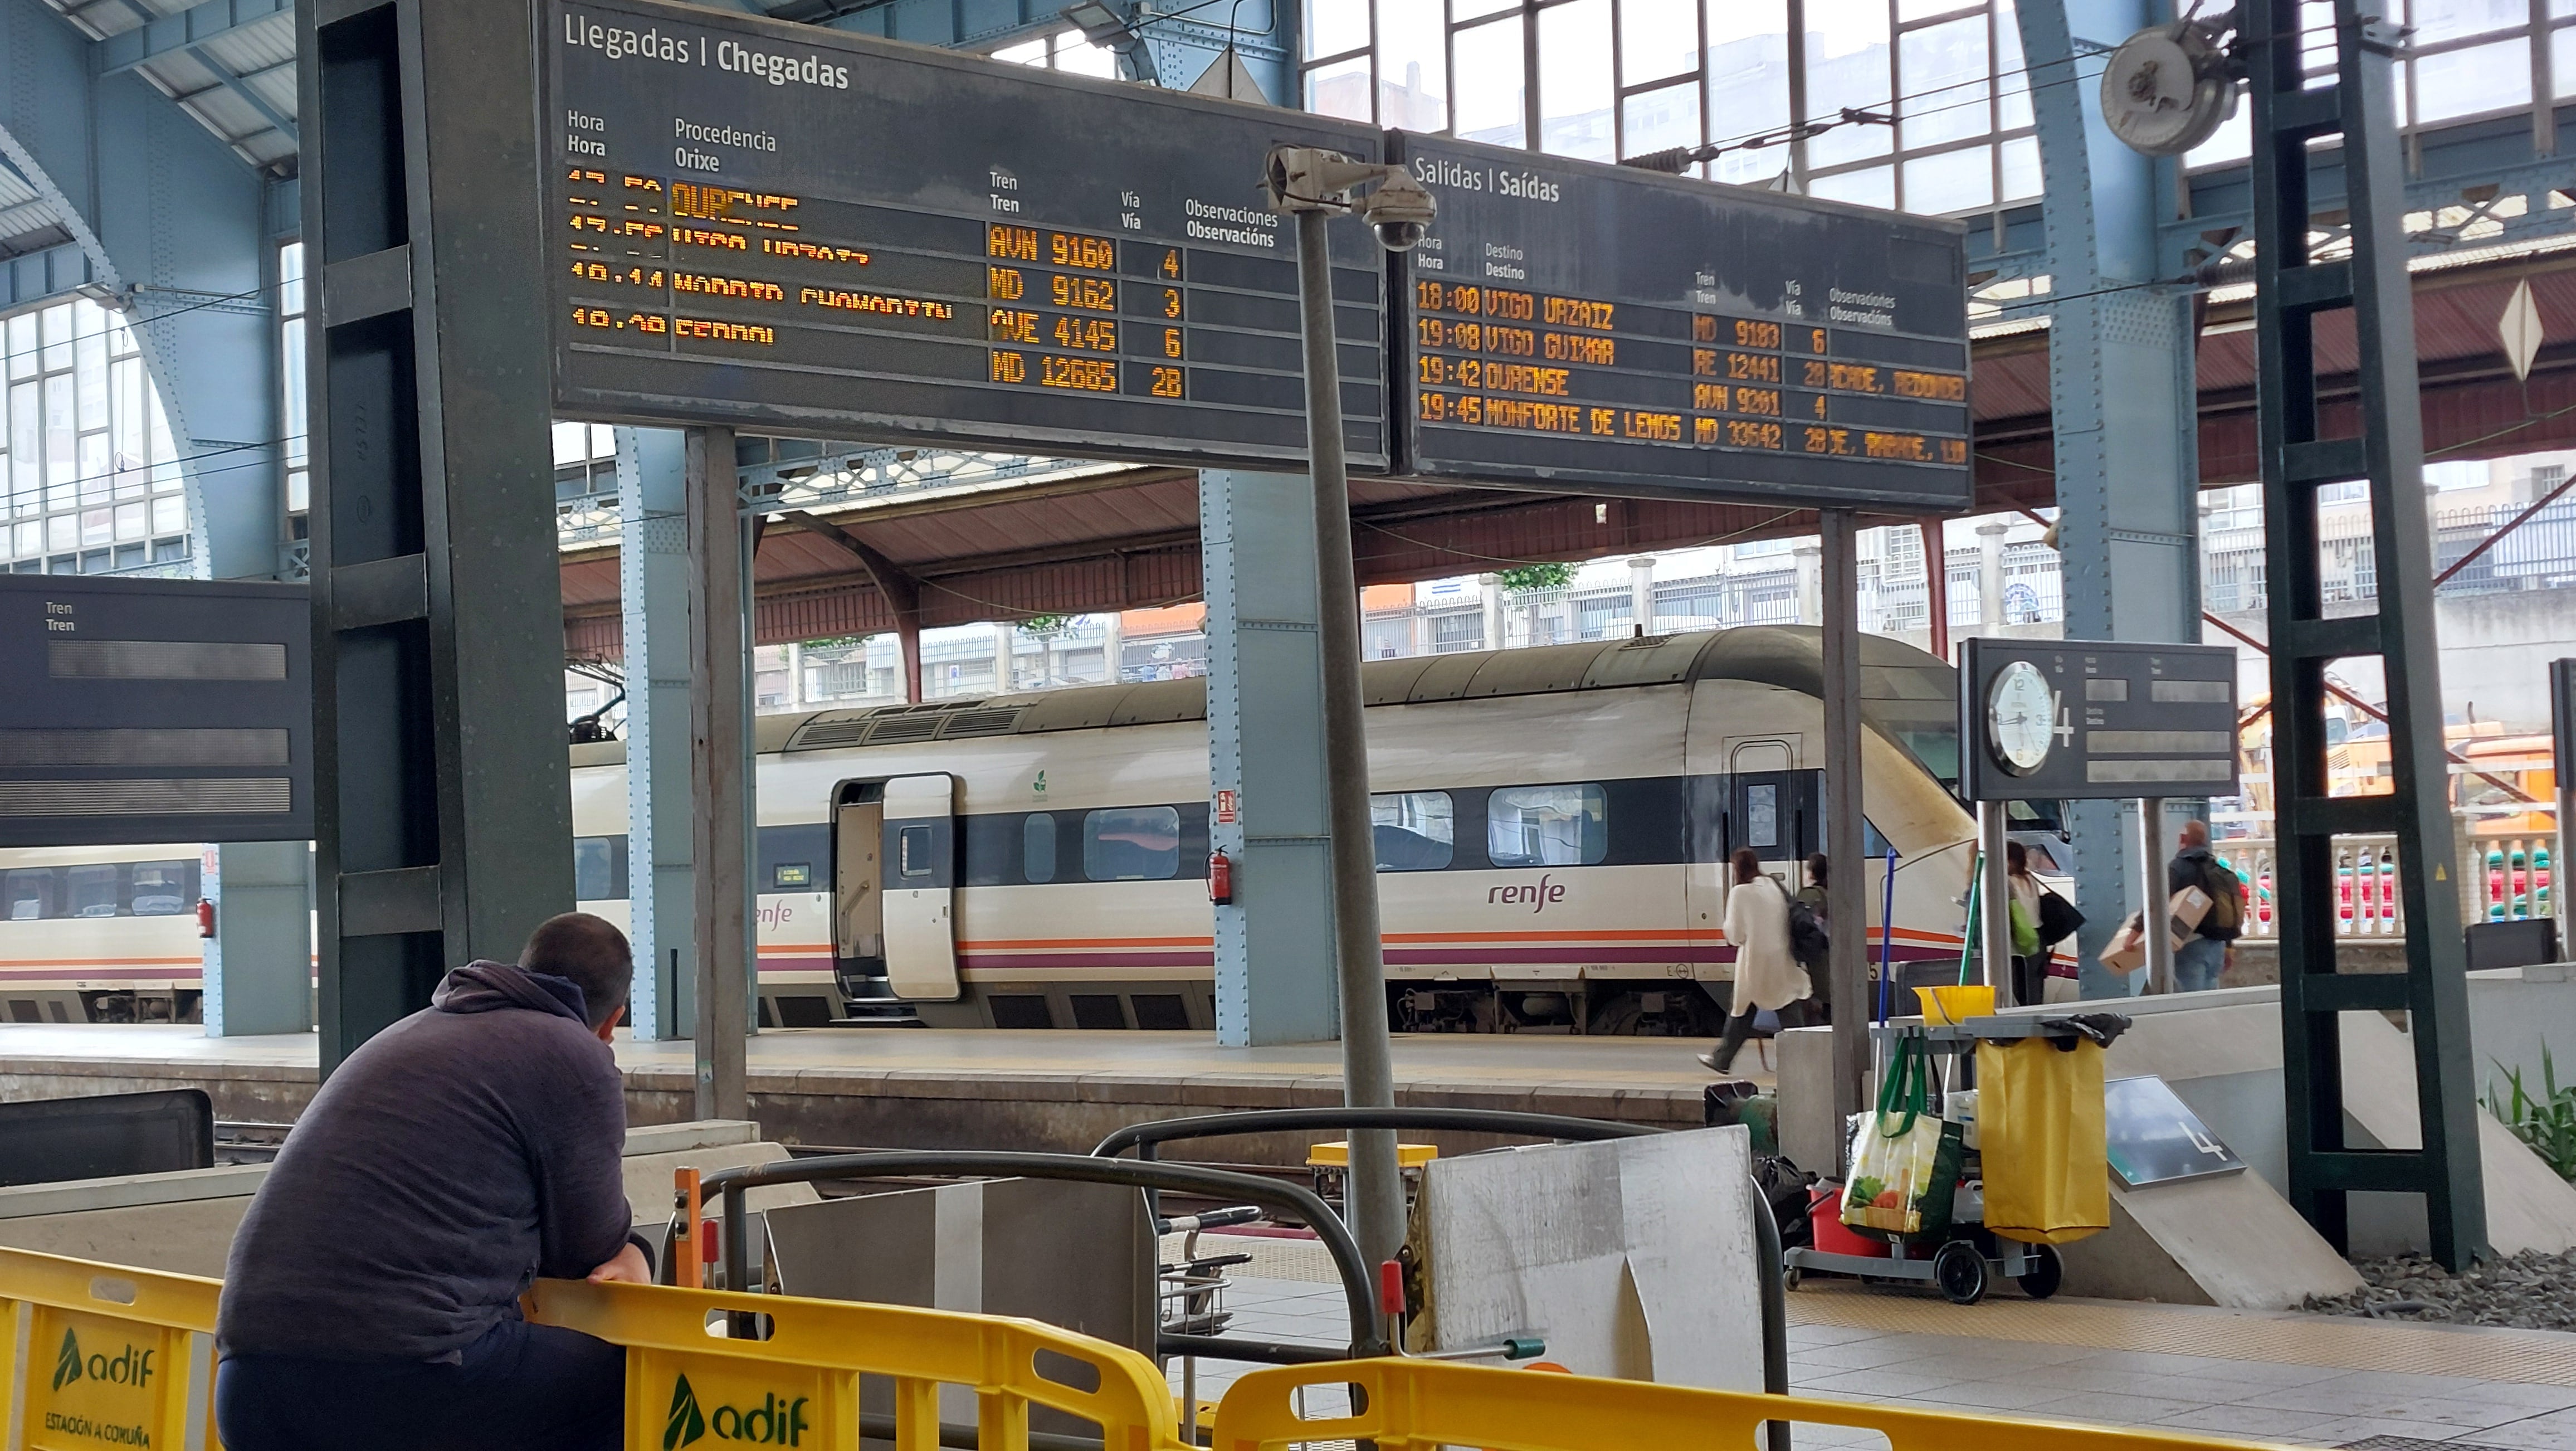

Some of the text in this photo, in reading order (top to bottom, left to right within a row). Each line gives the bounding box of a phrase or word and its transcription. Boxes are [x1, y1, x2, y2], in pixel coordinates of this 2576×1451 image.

[564, 13, 689, 64] Llegadas
[717, 40, 849, 90] Chegadas
[567, 110, 605, 132] Hora
[567, 135, 606, 157] Hora
[675, 118, 777, 152] Procedencia
[675, 147, 720, 173] Orixe
[989, 172, 1018, 191] Tren
[1416, 157, 1481, 191] Salidas
[1500, 171, 1560, 203] Saídas
[990, 194, 1019, 213] Tren
[1121, 191, 1140, 208] Vía
[1121, 213, 1141, 230] Vía
[1185, 199, 1278, 228] Observaciones
[1187, 221, 1275, 247] Observacións
[1418, 234, 1442, 250] Hora
[1053, 234, 1113, 270] 9160
[1164, 250, 1178, 277] 4
[1418, 254, 1443, 270] Hora
[1486, 243, 1523, 261] Destino
[1486, 262, 1525, 280] Destino
[1696, 272, 1715, 286] Tren
[990, 267, 1114, 311] MD 9162
[1696, 290, 1716, 304] Tren
[1786, 280, 1801, 296] Vía
[1829, 289, 1895, 309] Observaciones
[1164, 289, 1180, 318] 3
[1418, 281, 1614, 330] 18:00 VIGO URZAIZ
[1786, 300, 1802, 315] Vía
[1830, 306, 1892, 326] Observacións
[1055, 316, 1115, 351] 4145
[1419, 318, 1480, 352] 19:08
[1485, 325, 1534, 356] VIGO
[1695, 315, 1717, 342] MD
[1165, 328, 1180, 358] 6
[993, 352, 1116, 392] MD 12685
[1419, 356, 1569, 396] 19:42 OURENSE
[1695, 349, 1779, 383] RE 12441
[1420, 393, 1681, 441] 19:45 MONFORTE DE LEMOS
[1814, 395, 1826, 419] 4
[1695, 417, 1719, 445] MD
[46, 602, 72, 614] Tren
[46, 619, 75, 631] Tren
[2053, 690, 2074, 747] 4
[1488, 874, 1565, 913] renfe
[2178, 1122, 2227, 1161] 4
[87, 1344, 155, 1387] adif
[46, 1412, 150, 1449] ESTACIÓN A CORUÑA
[712, 1392, 809, 1447] adif
